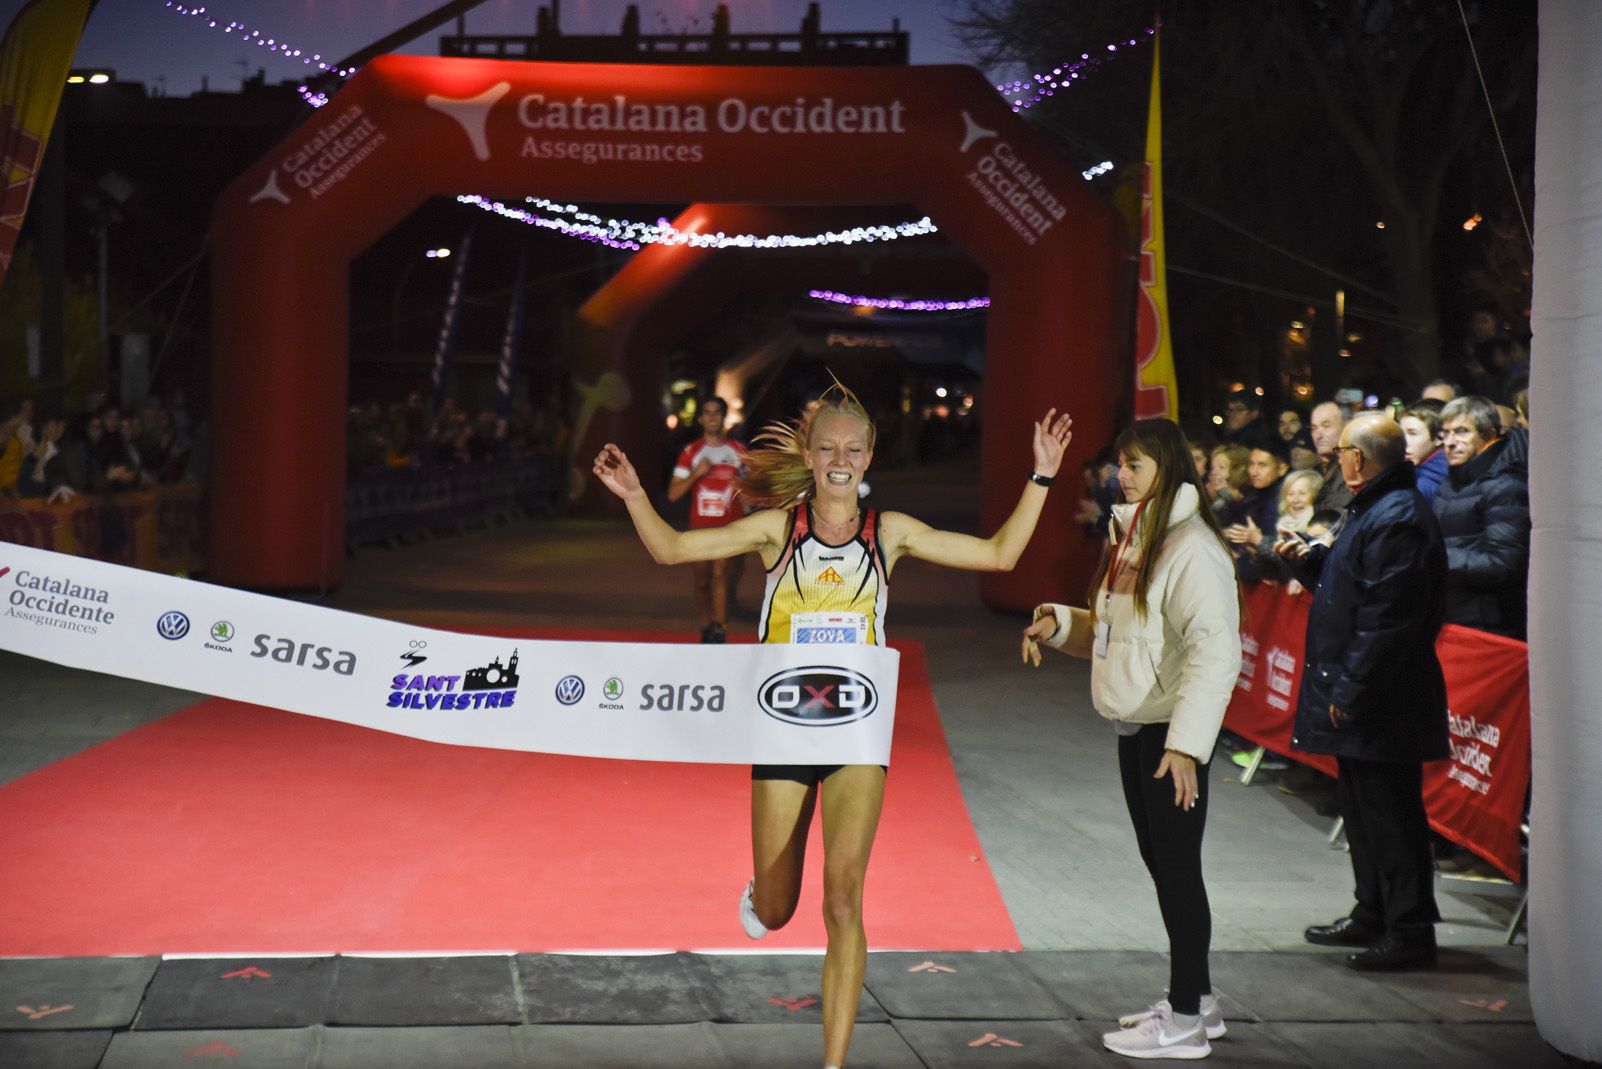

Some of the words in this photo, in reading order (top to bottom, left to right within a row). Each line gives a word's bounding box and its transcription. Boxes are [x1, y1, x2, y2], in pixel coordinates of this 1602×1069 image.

[518, 94, 708, 134] Catalana
[717, 97, 905, 135] Occident
[283, 104, 363, 173] Catalana
[294, 116, 377, 189] Occident
[521, 137, 704, 165] Assegurances
[310, 132, 386, 198] Assegurances
[993, 142, 1068, 220] Catalana
[977, 156, 1053, 237] Occident
[15, 570, 109, 603] Catalana
[4, 606, 98, 635] Assegurances
[9, 589, 115, 625] Occidente
[250, 633, 357, 676] sarsa
[386, 690, 517, 710] SILVESTRE
[391, 674, 461, 691] SANT
[639, 683, 725, 713] sarsa
[772, 685, 865, 708] OXD
